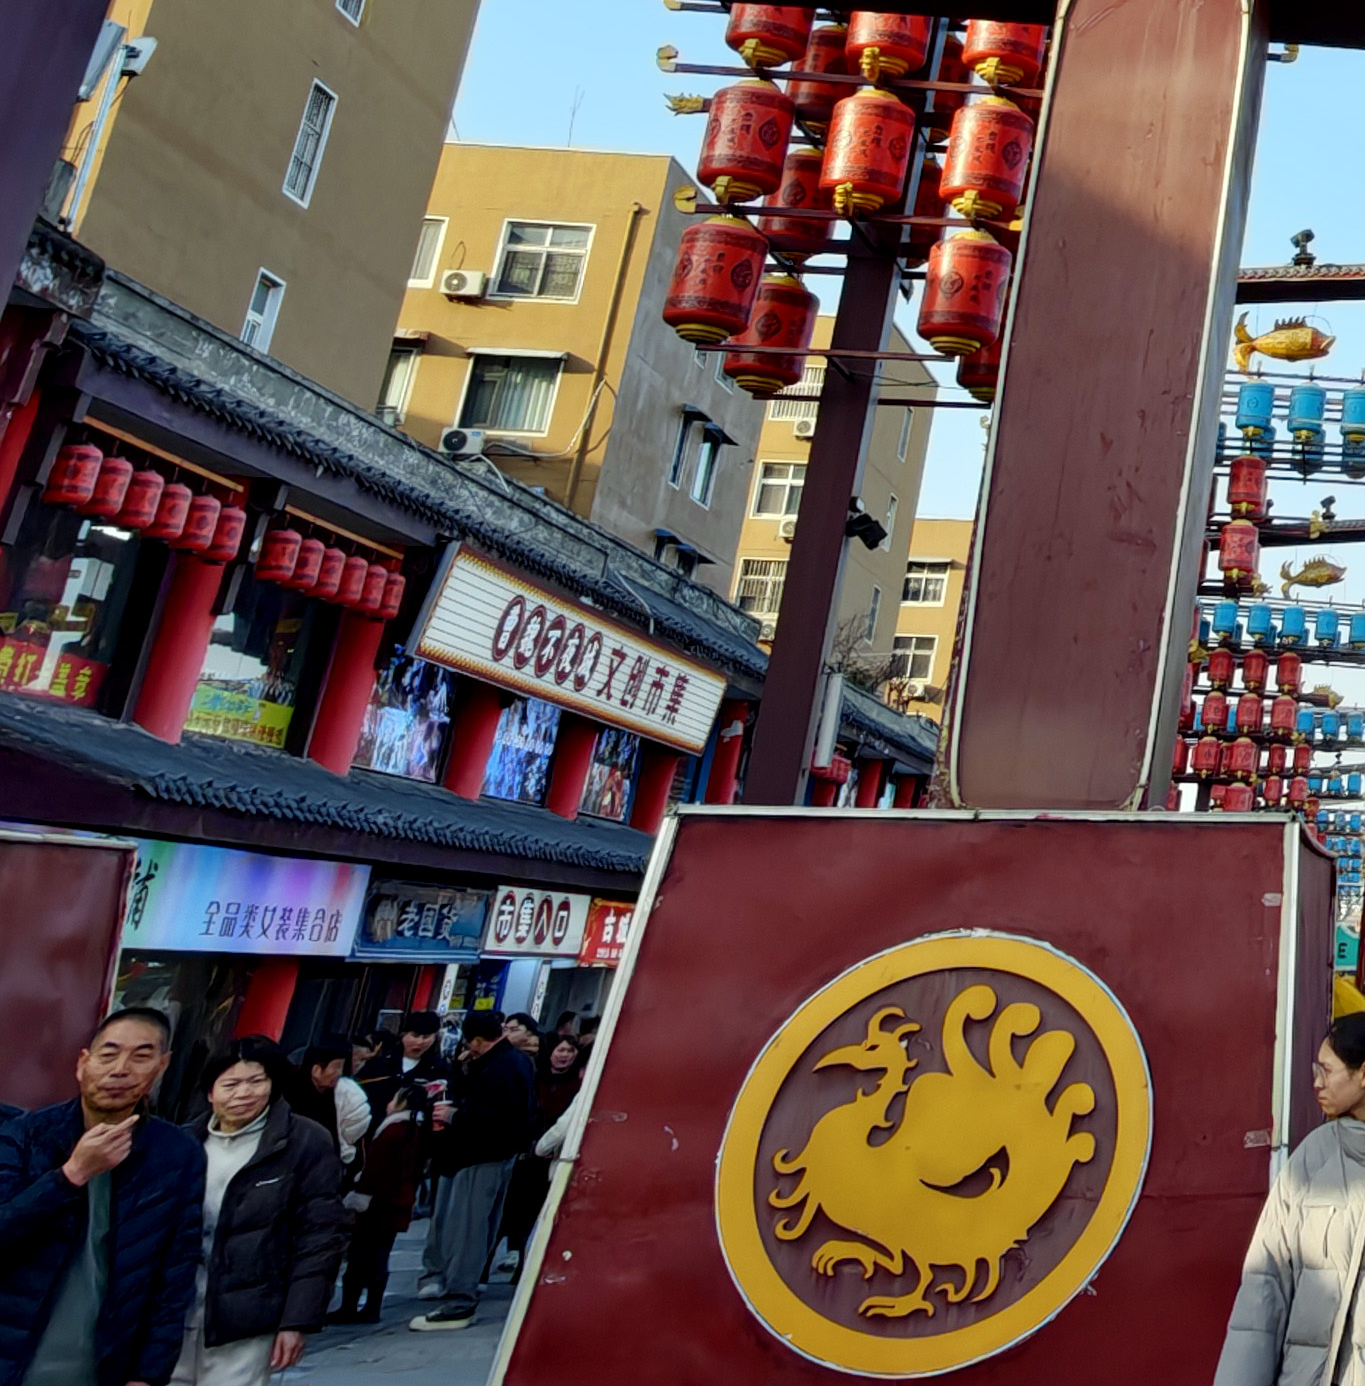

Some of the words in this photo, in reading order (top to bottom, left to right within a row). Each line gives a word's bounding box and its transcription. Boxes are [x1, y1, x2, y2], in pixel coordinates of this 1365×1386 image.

[198, 900, 342, 944] 全品类女装集合店
[496, 895, 569, 944] 市集入口
